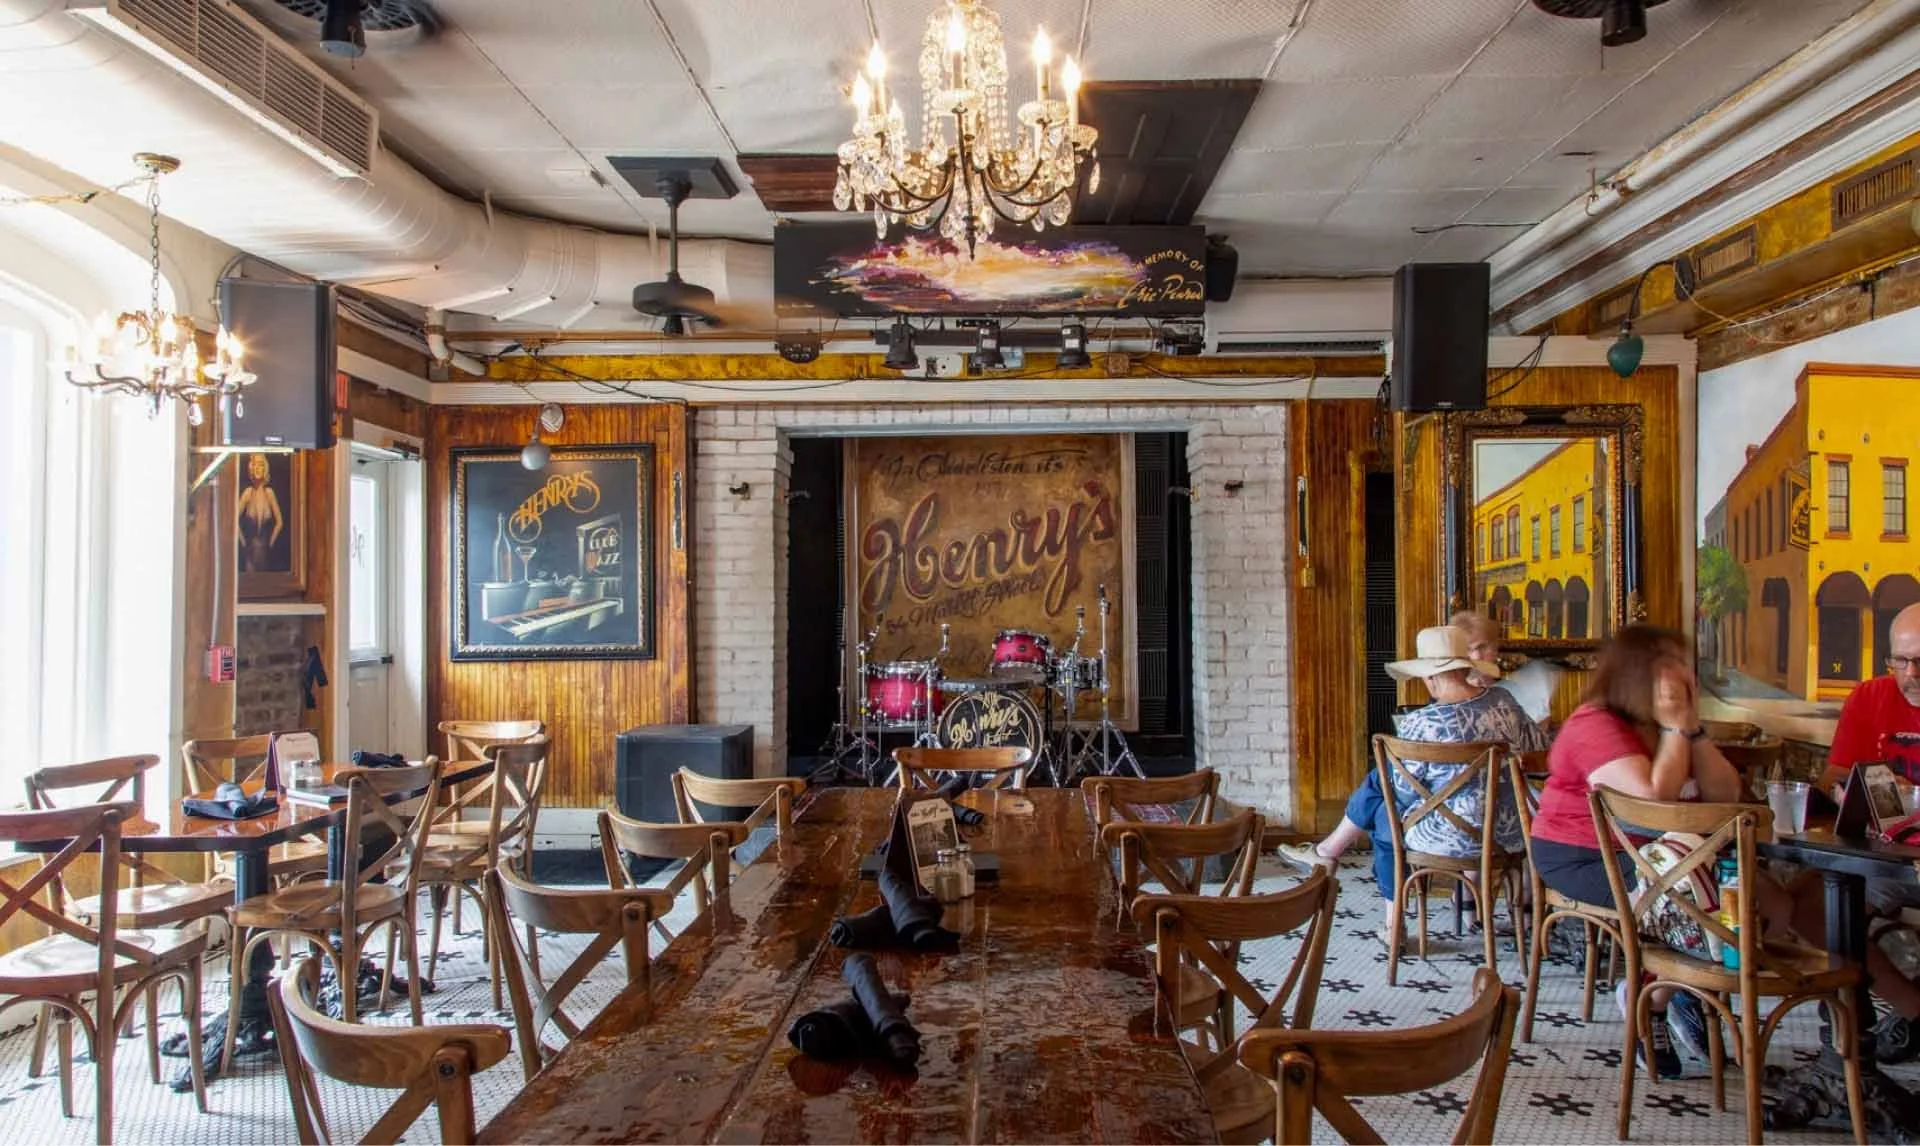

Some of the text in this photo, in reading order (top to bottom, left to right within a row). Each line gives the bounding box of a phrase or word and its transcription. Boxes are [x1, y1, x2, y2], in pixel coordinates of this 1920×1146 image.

[1145, 248, 1190, 266] MEMORY
[1190, 259, 1205, 272] OF
[861, 479, 1116, 619] Henry's
